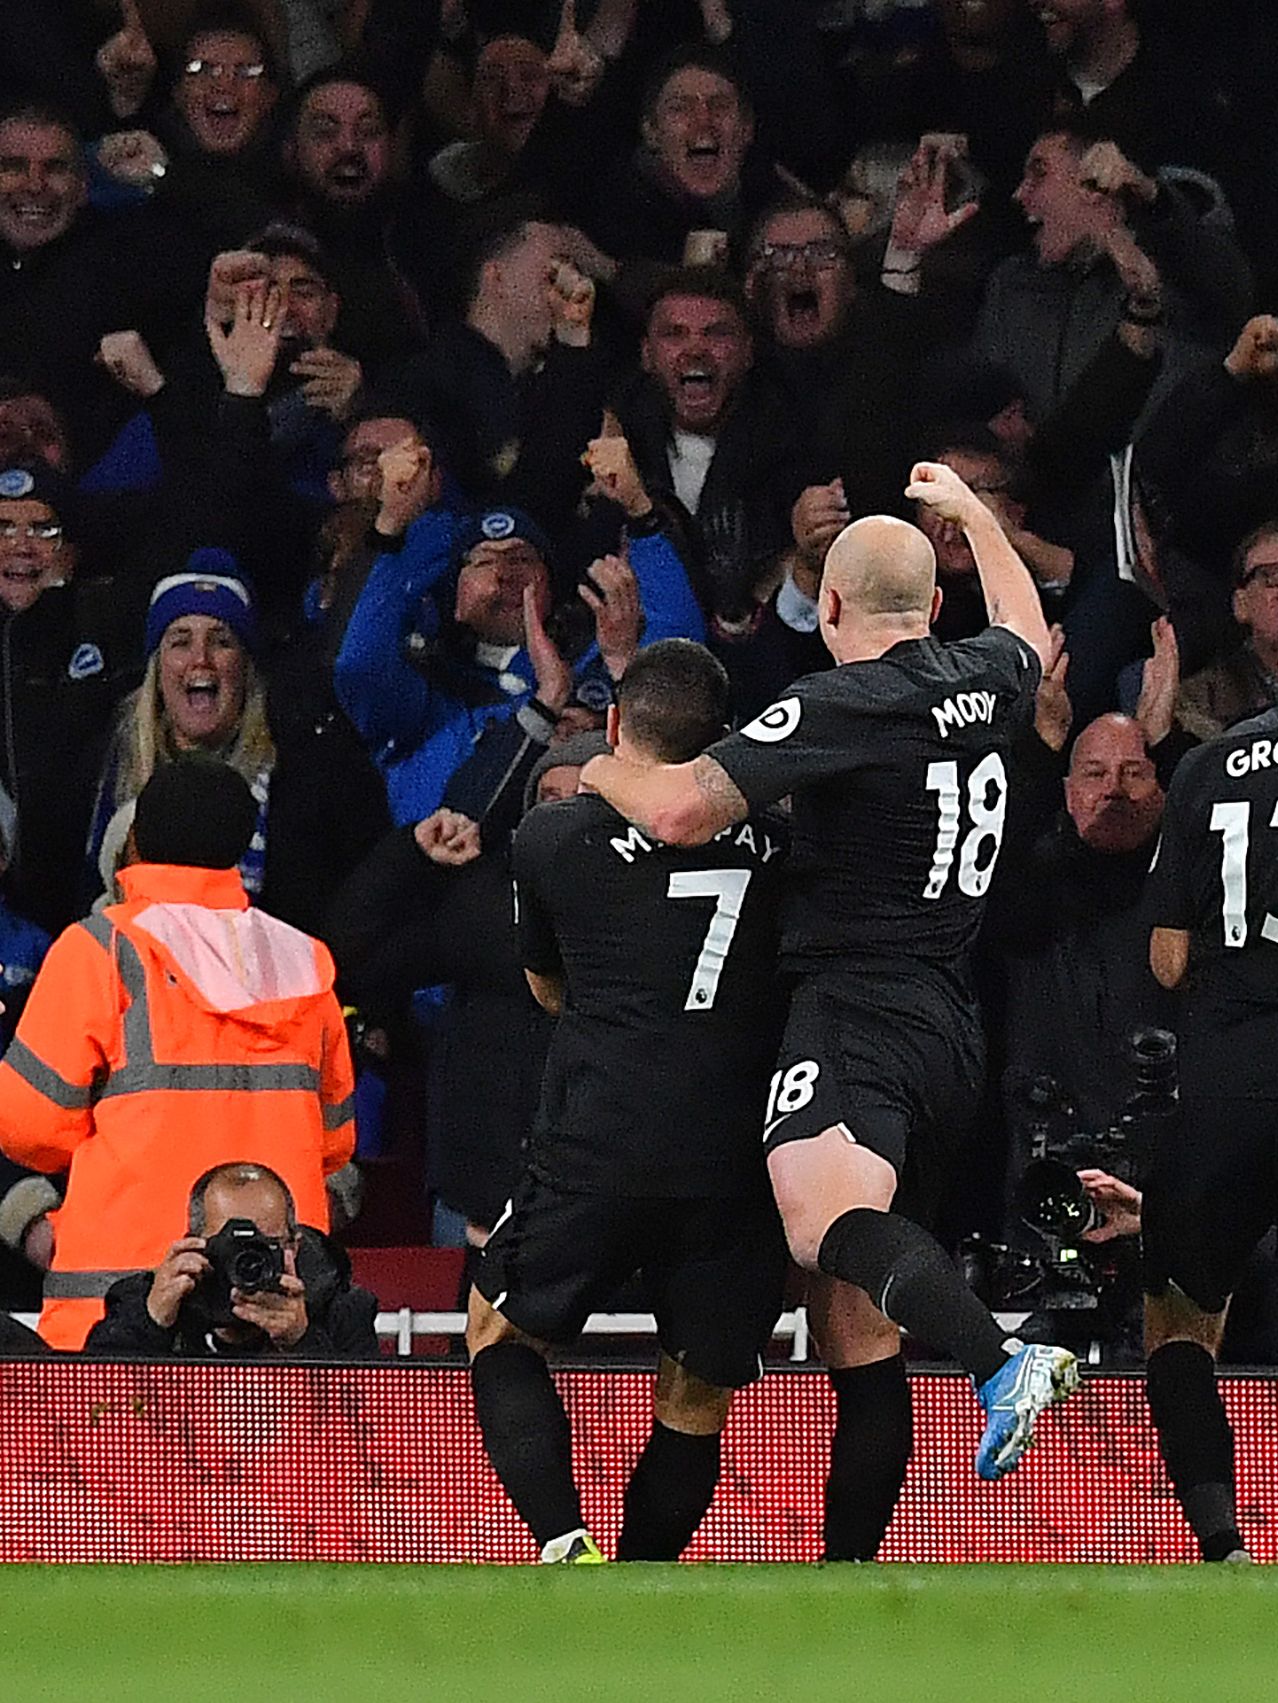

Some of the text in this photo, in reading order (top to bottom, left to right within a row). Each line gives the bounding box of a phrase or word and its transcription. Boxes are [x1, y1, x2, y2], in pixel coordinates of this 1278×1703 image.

[923, 752, 1007, 898] 18
[667, 870, 752, 1010] 7
[764, 1060, 819, 1124] 18
